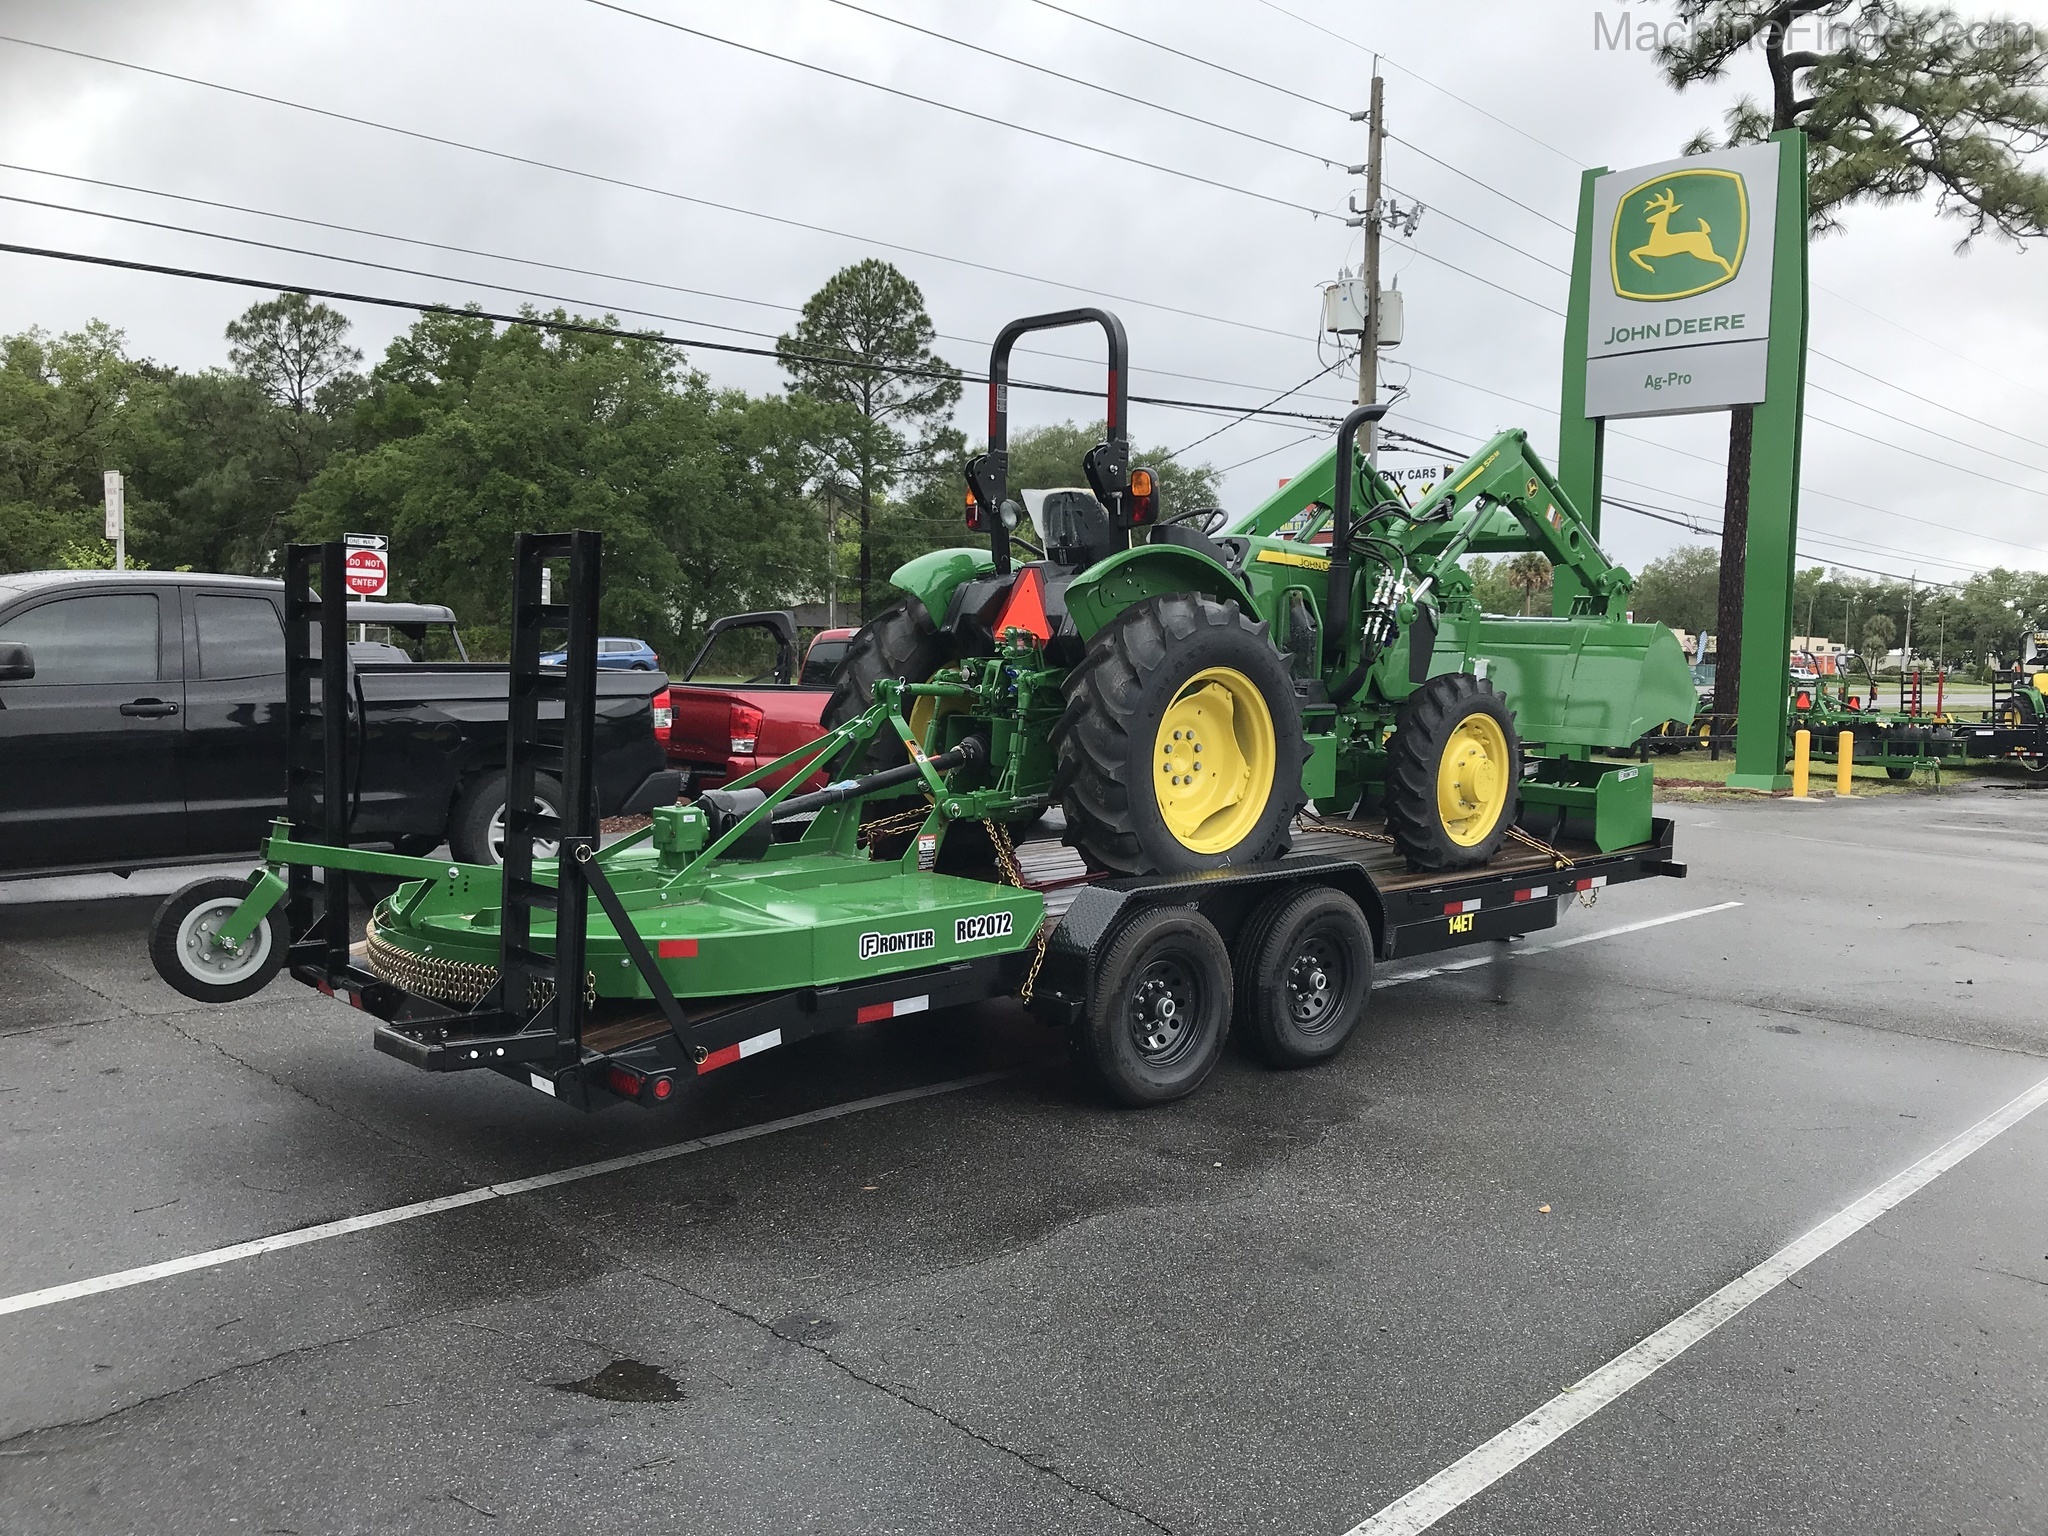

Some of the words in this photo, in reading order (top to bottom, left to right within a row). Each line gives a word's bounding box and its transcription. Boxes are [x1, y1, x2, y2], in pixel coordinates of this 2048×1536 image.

[1604, 323, 1661, 345] JOHN
[1665, 314, 1746, 337] DEERE
[1644, 372, 1692, 390] Ag-Pro
[1382, 470, 1404, 481] BUY
[1407, 468, 1437, 480] CARS
[349, 558, 361, 566] DO
[365, 560, 381, 568] NOT
[1299, 558, 1321, 570] JOHN
[352, 578, 378, 587] ENTER
[1449, 913, 1474, 934] 14ET
[861, 930, 934, 958] FRONTIER
[957, 914, 1011, 941] RC2072
